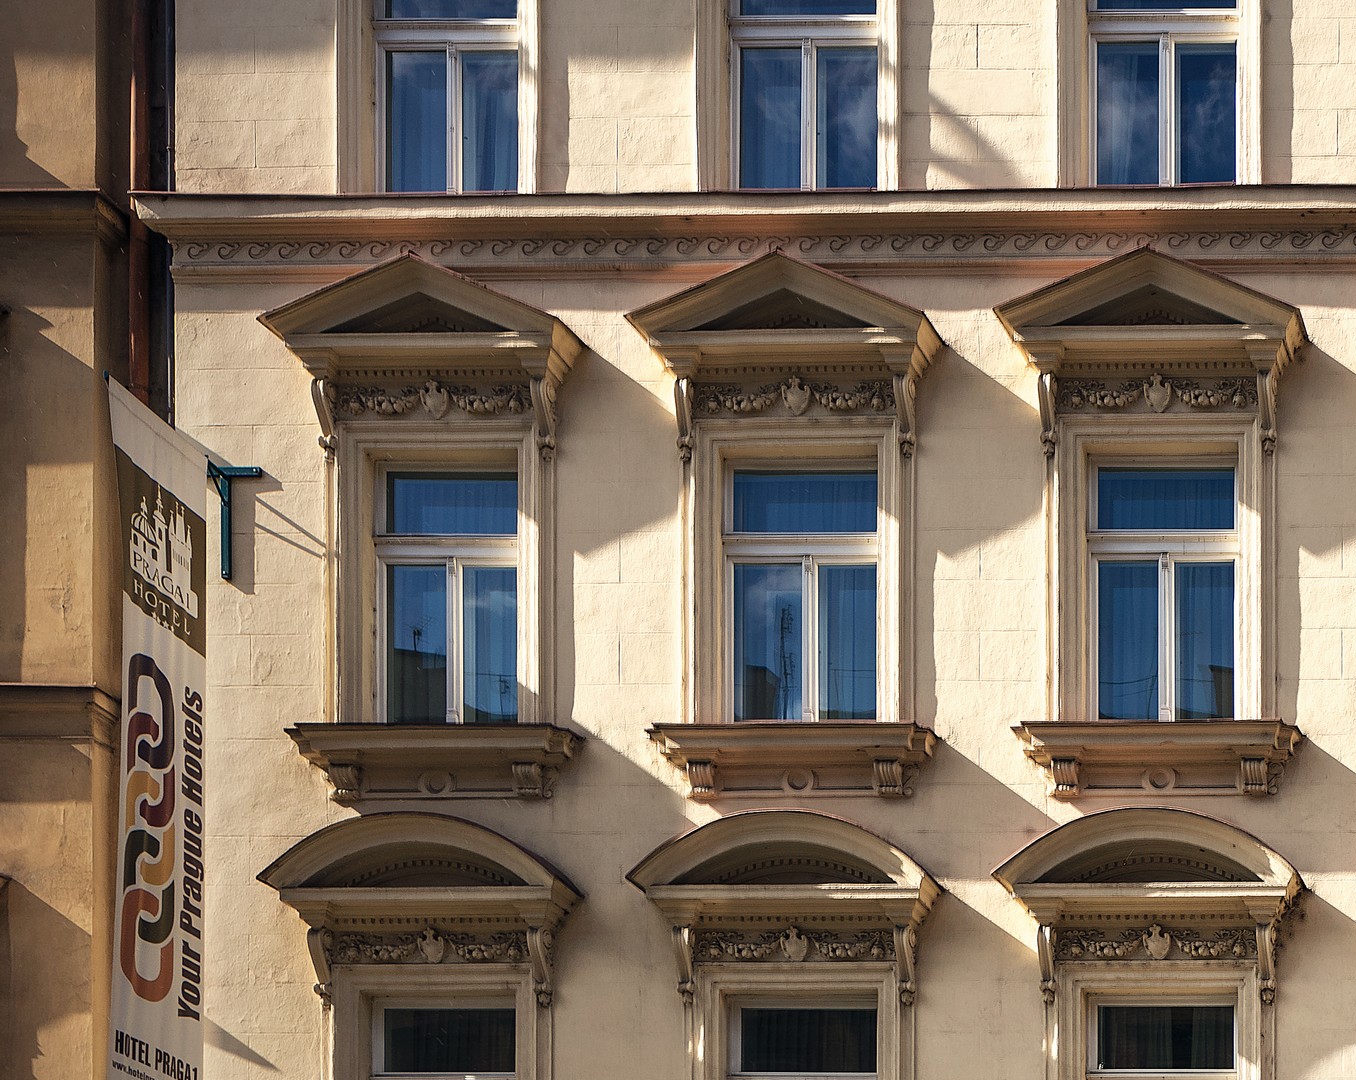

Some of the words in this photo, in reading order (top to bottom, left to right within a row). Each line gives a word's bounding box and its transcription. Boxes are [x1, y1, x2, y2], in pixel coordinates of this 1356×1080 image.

[132, 578, 191, 636] HOTEL
[181, 685, 203, 807] Hotels
[179, 807, 204, 941] Prague
[177, 939, 201, 1022] Your
[114, 1029, 152, 1067] HOTEL
